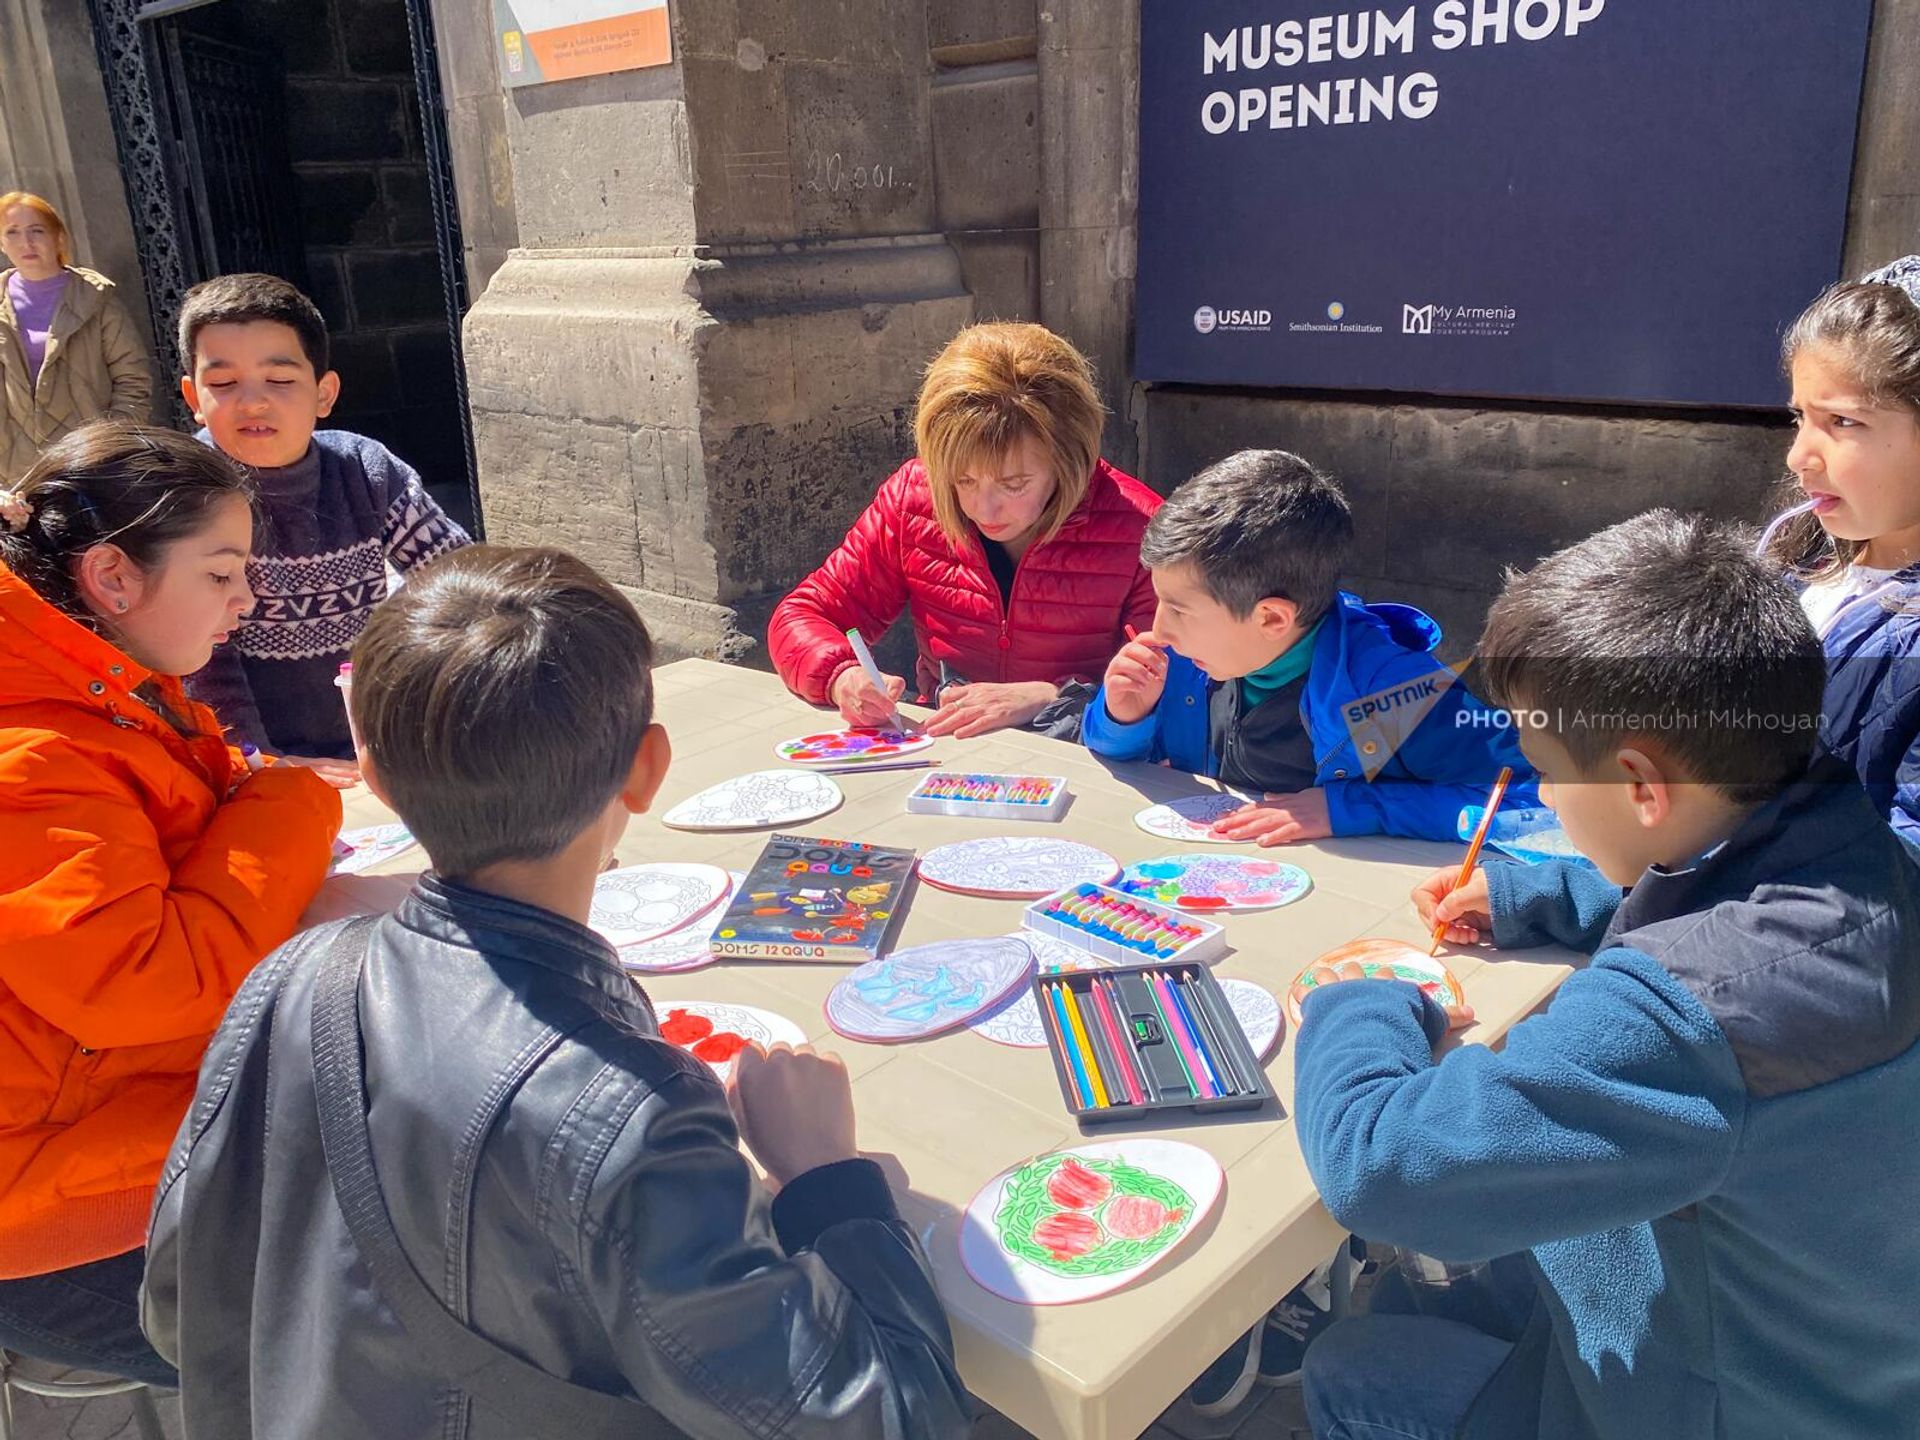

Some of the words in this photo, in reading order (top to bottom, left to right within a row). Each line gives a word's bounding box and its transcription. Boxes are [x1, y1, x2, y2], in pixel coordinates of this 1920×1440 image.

[1203, 6, 1416, 74] MUSEUM
[1431, 0, 1605, 50] SHOP
[1201, 72, 1438, 135] OPENING
[1218, 309, 1272, 326] USAID
[1432, 304, 1453, 321] My
[1455, 304, 1516, 320] Armenia
[1288, 321, 1338, 332] Smithsonian
[1339, 322, 1383, 333] Institution
[712, 942, 760, 955] DOMS
[765, 944, 780, 955] 12
